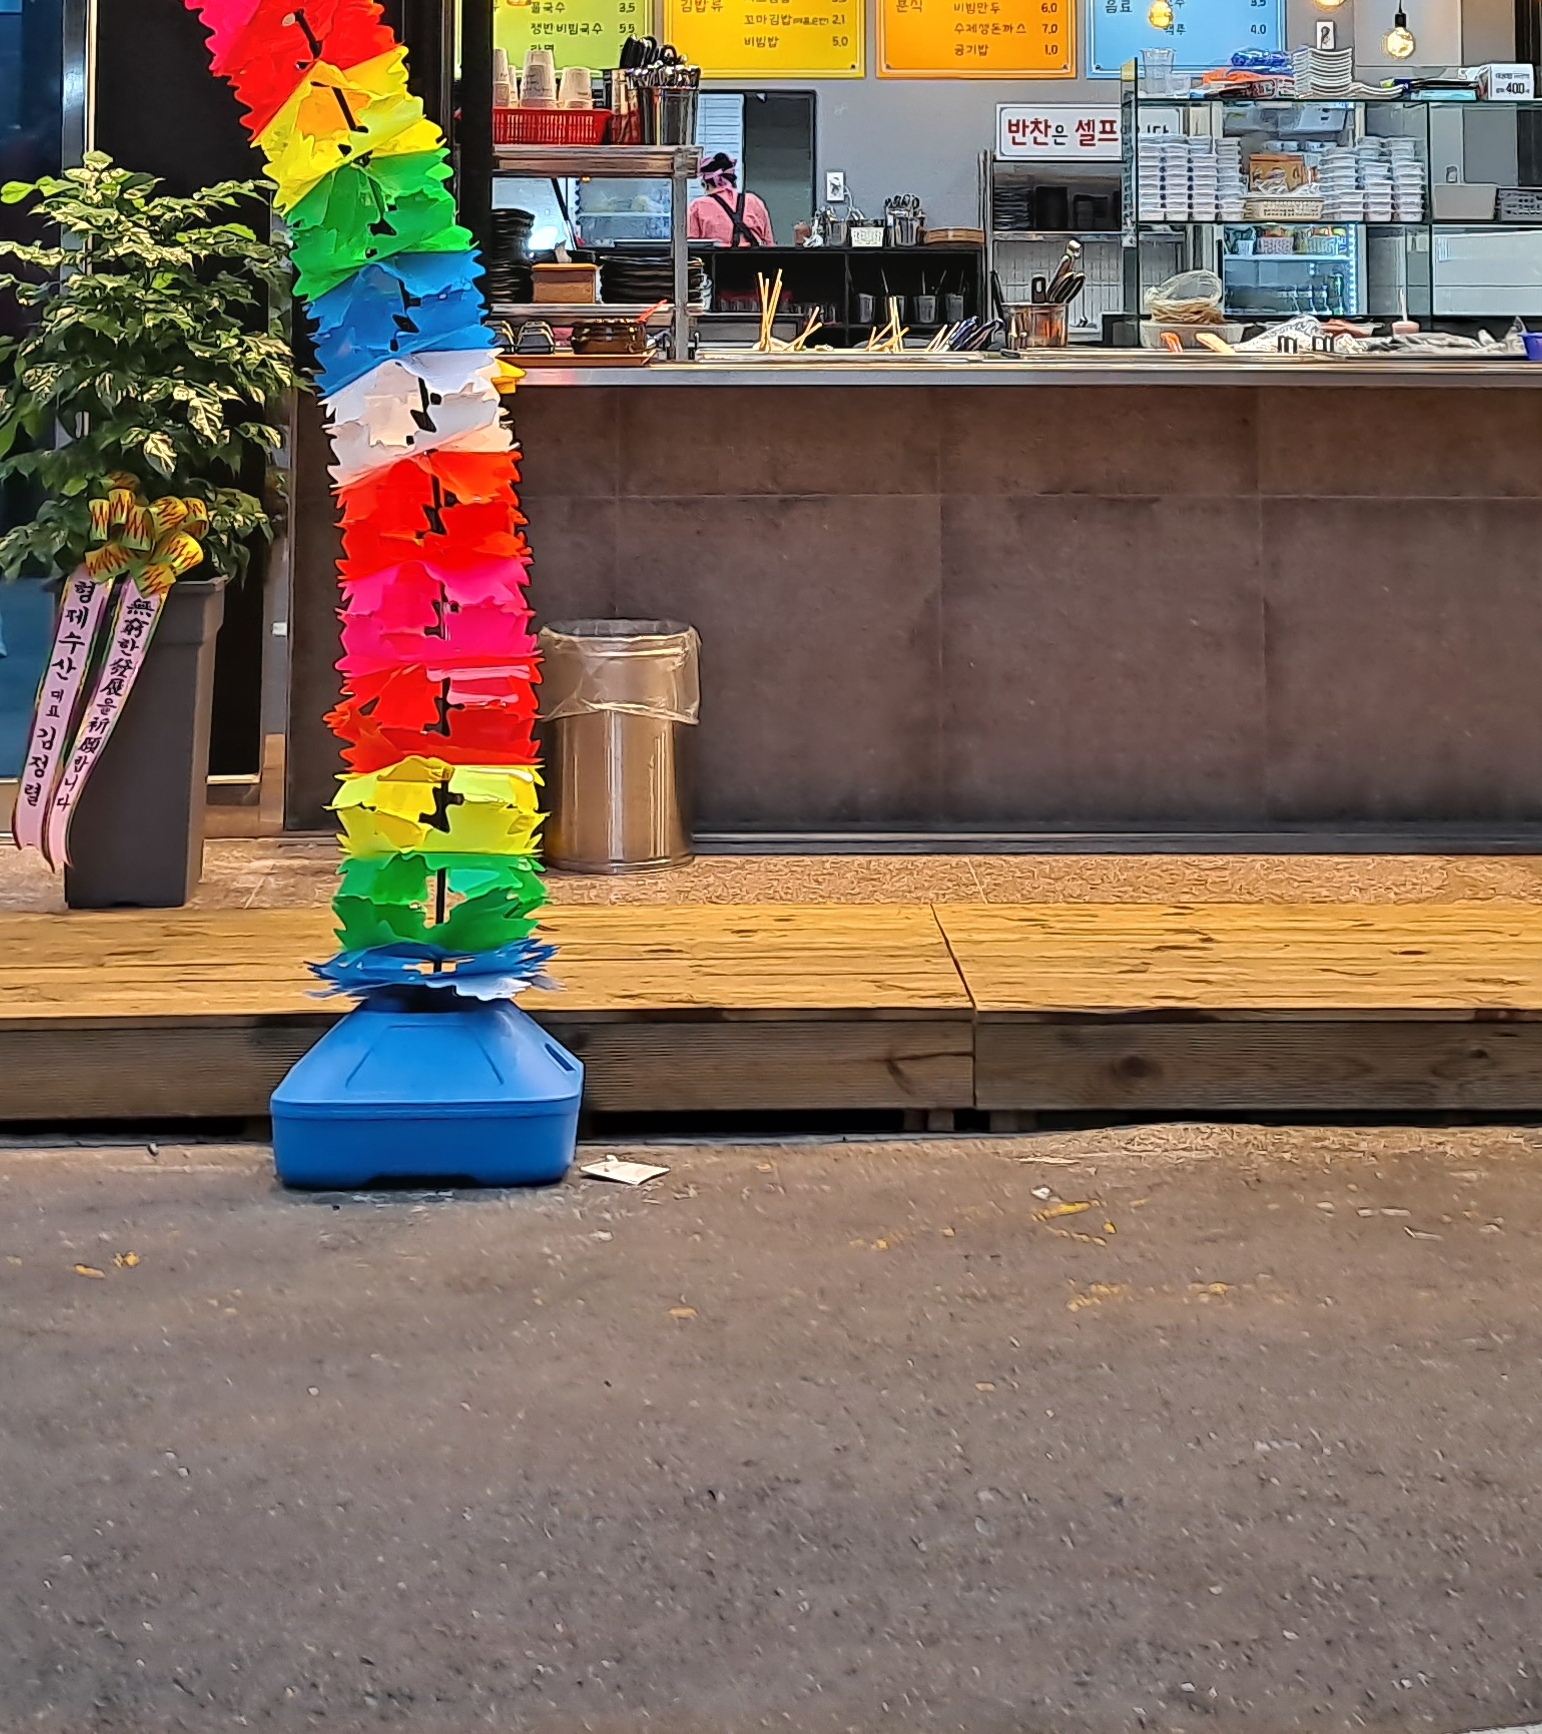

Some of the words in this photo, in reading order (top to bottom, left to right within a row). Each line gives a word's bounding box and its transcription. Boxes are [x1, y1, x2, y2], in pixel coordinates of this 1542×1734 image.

[1105, 0, 1133, 14] 음료
[832, 35, 849, 48] 5.0
[1008, 119, 1068, 146] 반찬은
[1075, 119, 1119, 147] 셀프
